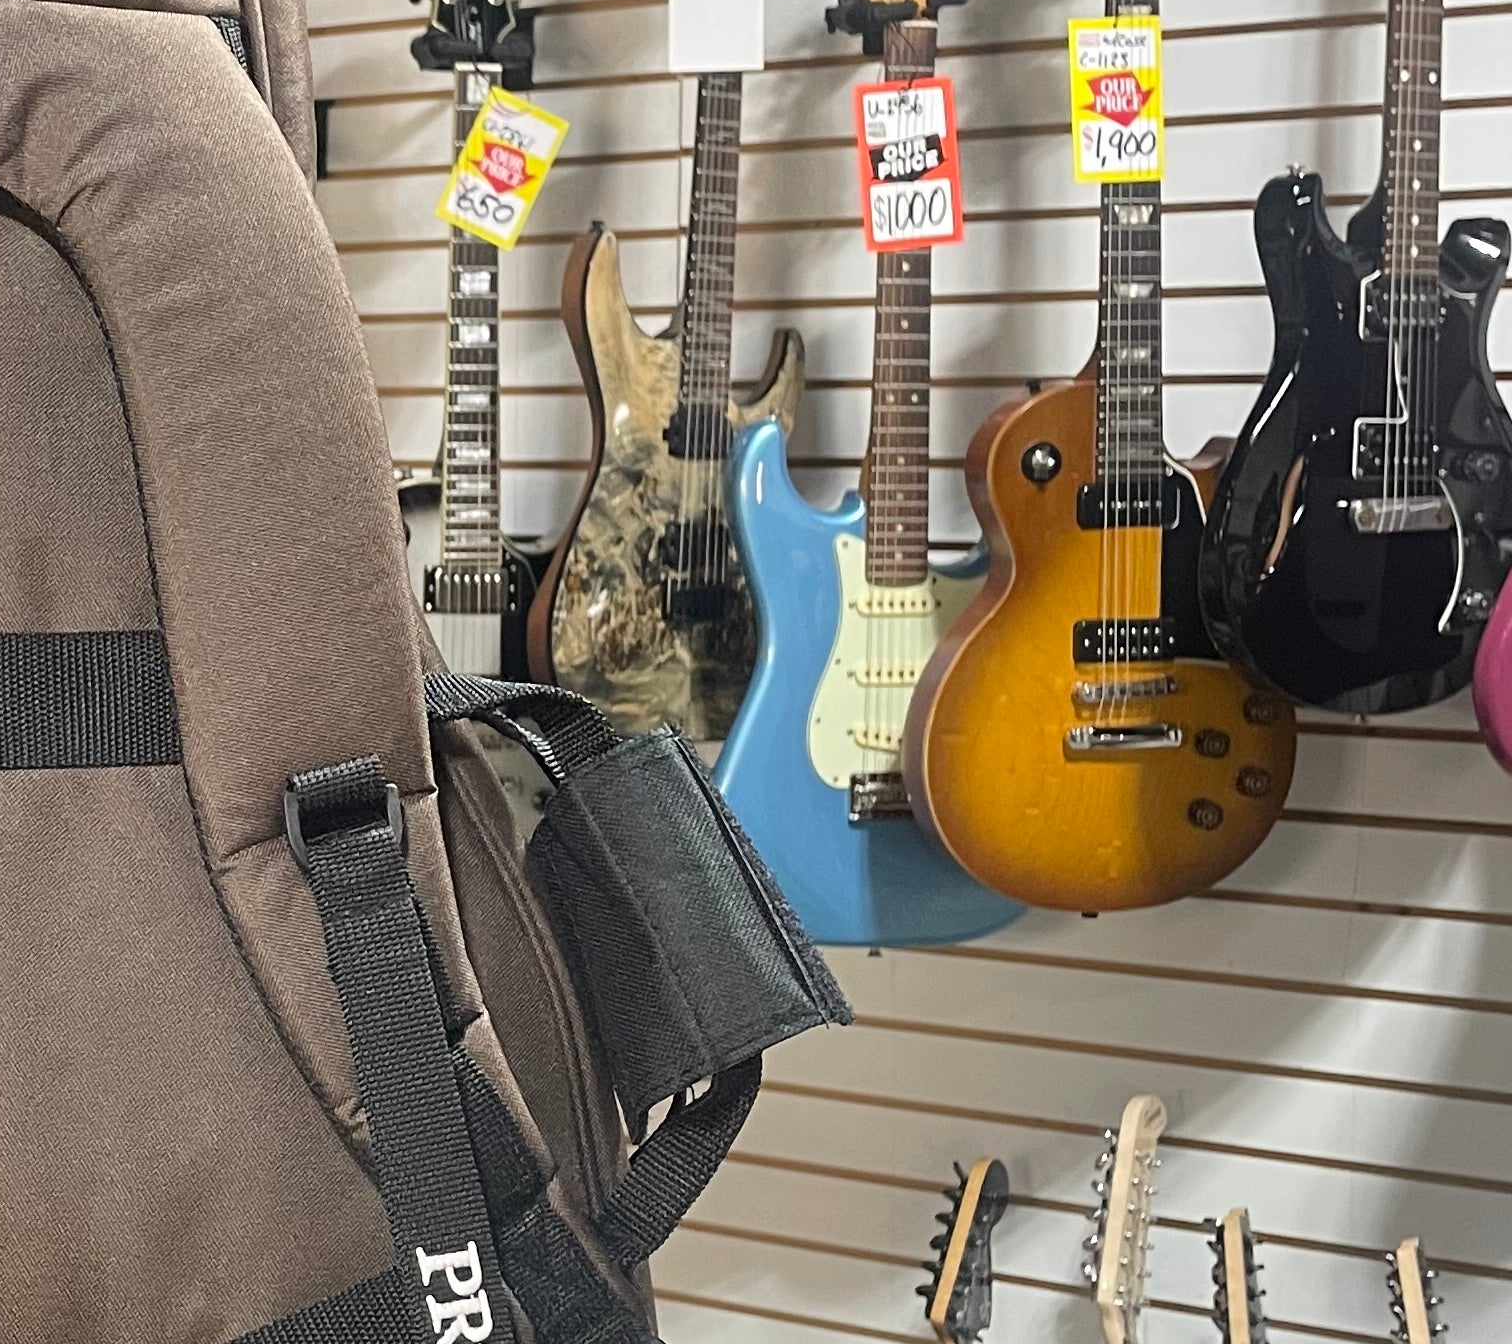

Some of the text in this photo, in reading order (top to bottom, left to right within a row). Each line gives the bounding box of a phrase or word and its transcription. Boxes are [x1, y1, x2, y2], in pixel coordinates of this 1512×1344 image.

[1100, 77, 1137, 95] OUR
[1096, 94, 1143, 113] PRICE
[882, 135, 927, 162] OUR
[877, 149, 939, 181] PRICE
[874, 186, 947, 237] $1000
